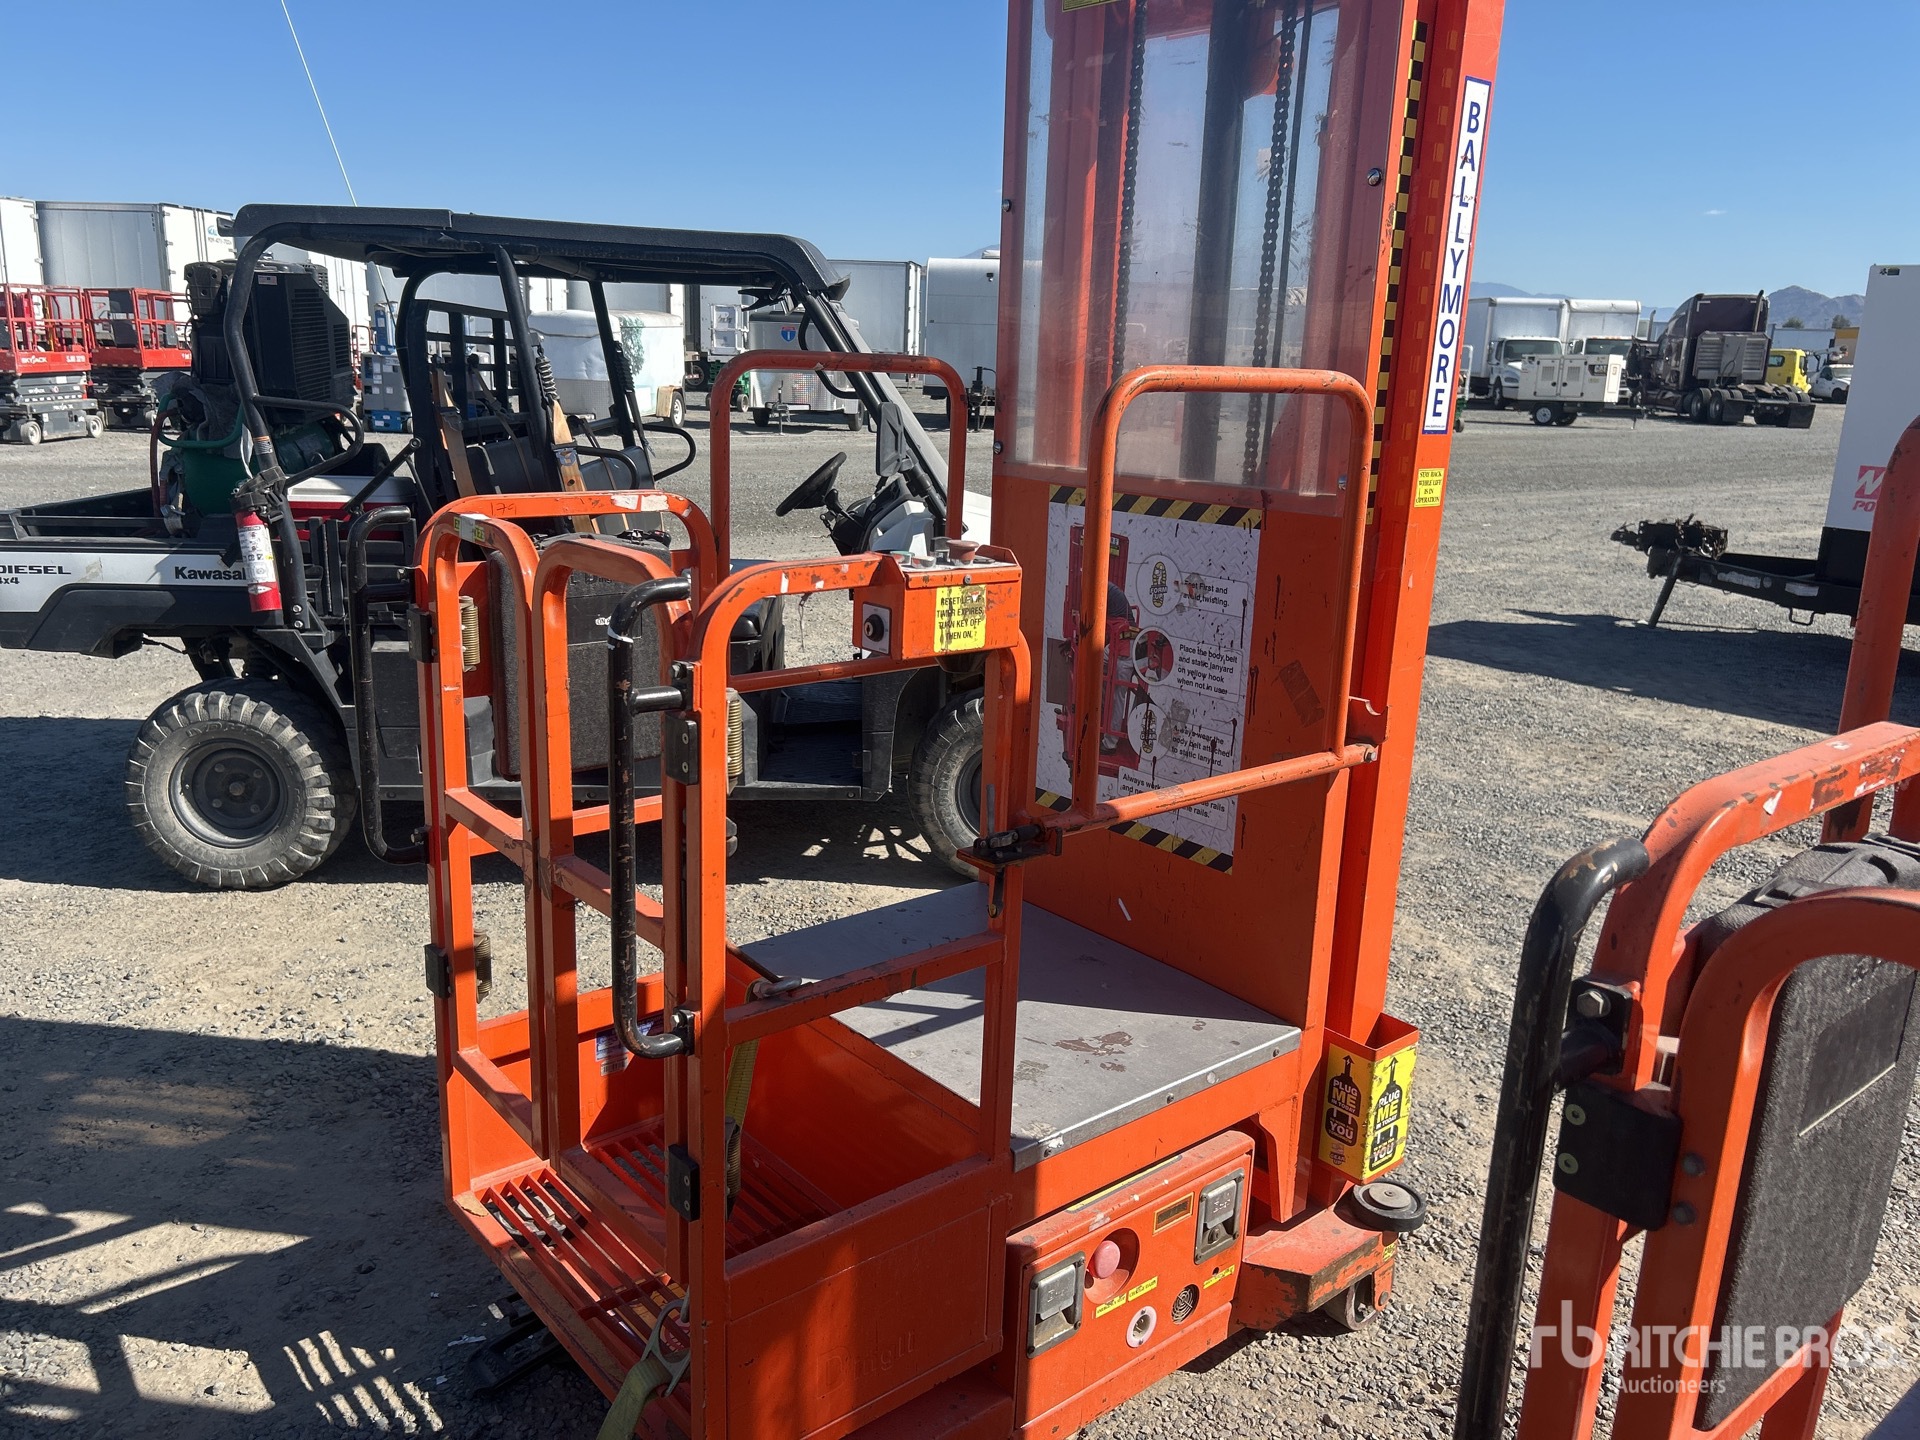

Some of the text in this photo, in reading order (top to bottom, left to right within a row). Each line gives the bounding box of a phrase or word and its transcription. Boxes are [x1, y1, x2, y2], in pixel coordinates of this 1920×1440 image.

[1432, 101, 1481, 417] BALLYMORE
[0, 565, 71, 575] DIESEL
[174, 566, 247, 581] Kawasa
[1215, 586, 1228, 594] and
[938, 617, 982, 630] TURN KEY OFF
[946, 631, 962, 640] THEN
[1180, 643, 1238, 664] Place the body belt
[1178, 656, 1234, 674] and static lanyard
[1177, 666, 1225, 683] on yellow hook
[1177, 677, 1194, 687] when
[1194, 681, 1206, 690] not
[1206, 683, 1213, 692] in
[1171, 746, 1178, 754] to
[1179, 748, 1197, 759] static
[1189, 740, 1202, 750] belt
[1202, 742, 1230, 758] attched
[1122, 784, 1134, 792] and
[1122, 773, 1145, 787] Always
[1210, 801, 1226, 813] rails
[1333, 1079, 1358, 1096] PLUG
[1332, 1088, 1357, 1109] ME
[1378, 1089, 1401, 1108] PLUG
[1338, 1102, 1356, 1114] TODAY
[1376, 1099, 1400, 1124] ME
[1382, 1114, 1398, 1127] TODAY
[1330, 1121, 1354, 1140] YOU
[1373, 1143, 1395, 1162] YOU
